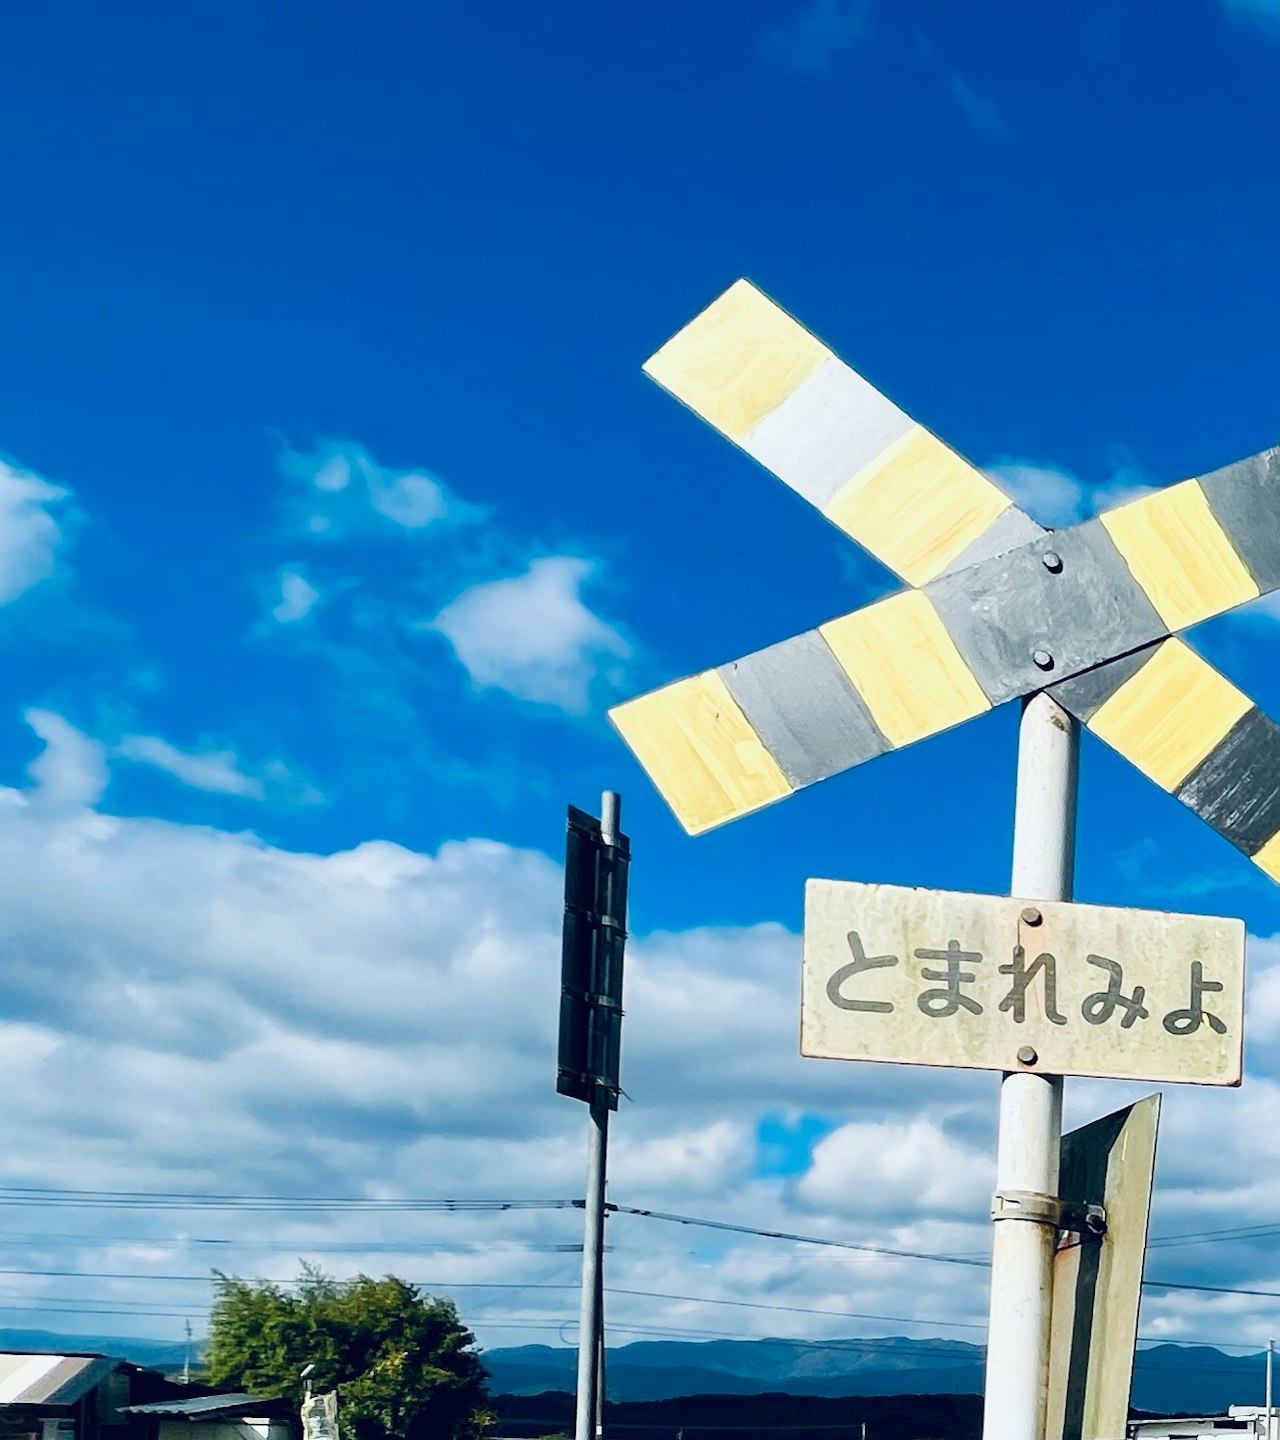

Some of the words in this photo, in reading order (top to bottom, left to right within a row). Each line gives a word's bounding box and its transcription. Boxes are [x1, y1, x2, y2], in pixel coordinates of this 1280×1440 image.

[826, 930, 1227, 1035] とまれみよ
